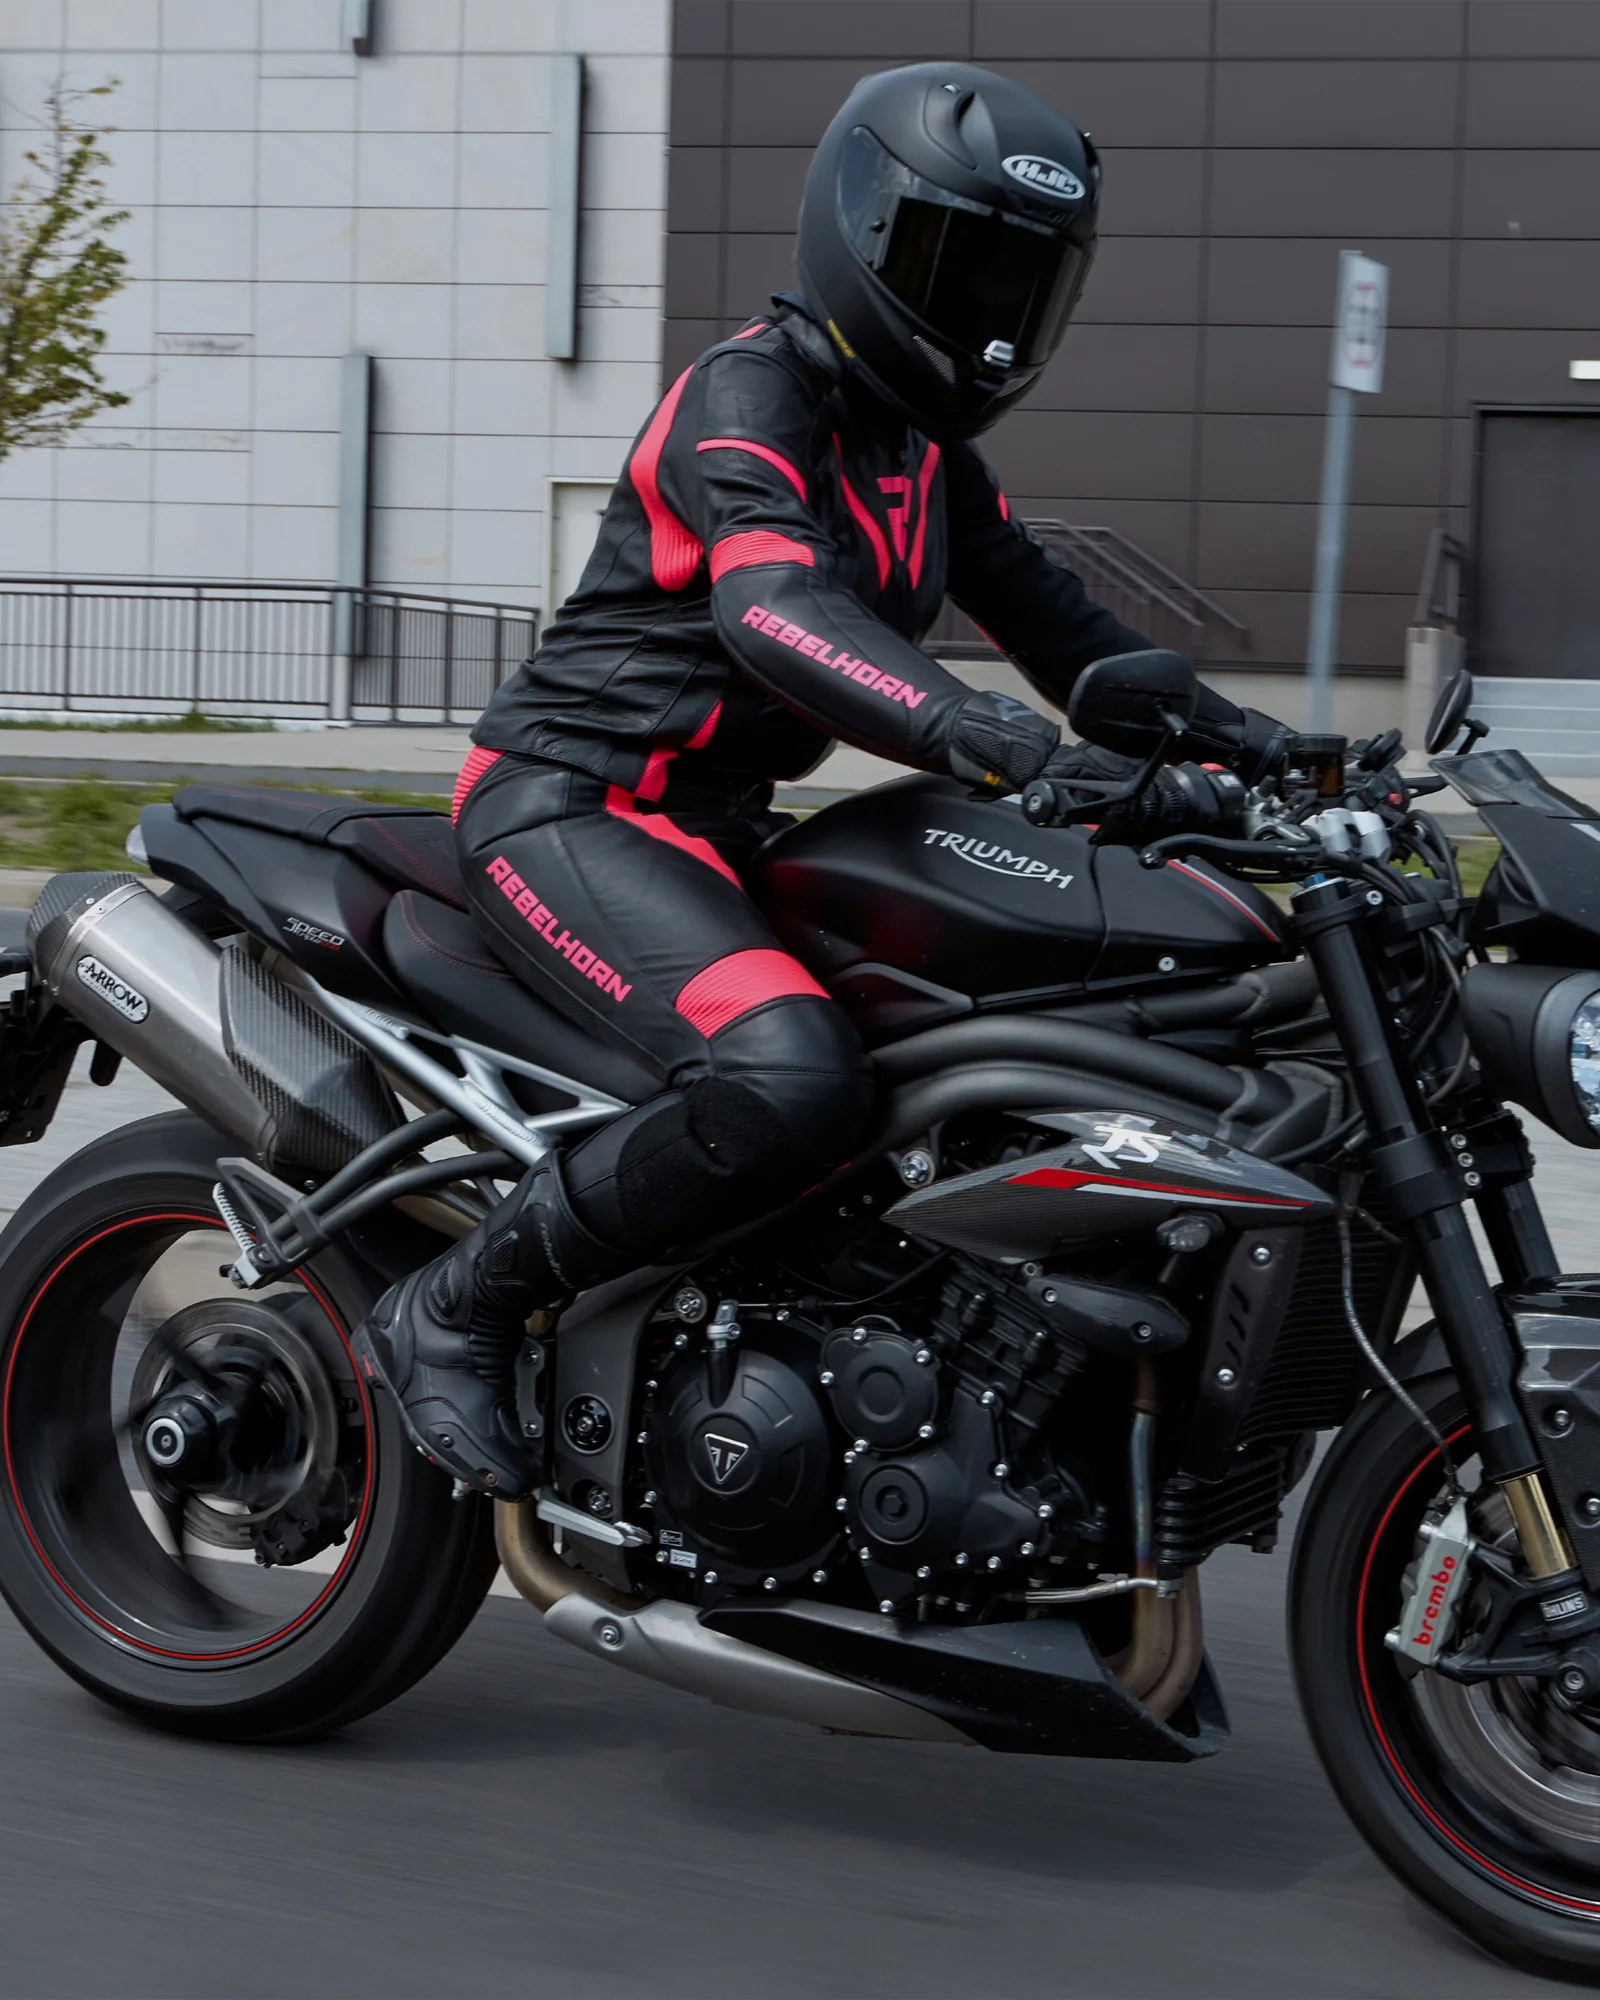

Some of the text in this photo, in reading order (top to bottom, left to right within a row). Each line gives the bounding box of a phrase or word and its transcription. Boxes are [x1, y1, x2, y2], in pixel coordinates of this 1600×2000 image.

[1014, 160, 1079, 194] HJC
[740, 604, 928, 709] REBELHORN
[924, 828, 1074, 890] TRIUMPH
[282, 916, 346, 946] SPEED
[485, 855, 633, 1003] REBELHORN
[84, 962, 144, 1011] ARROW
[1412, 1555, 1457, 1646] brembo
